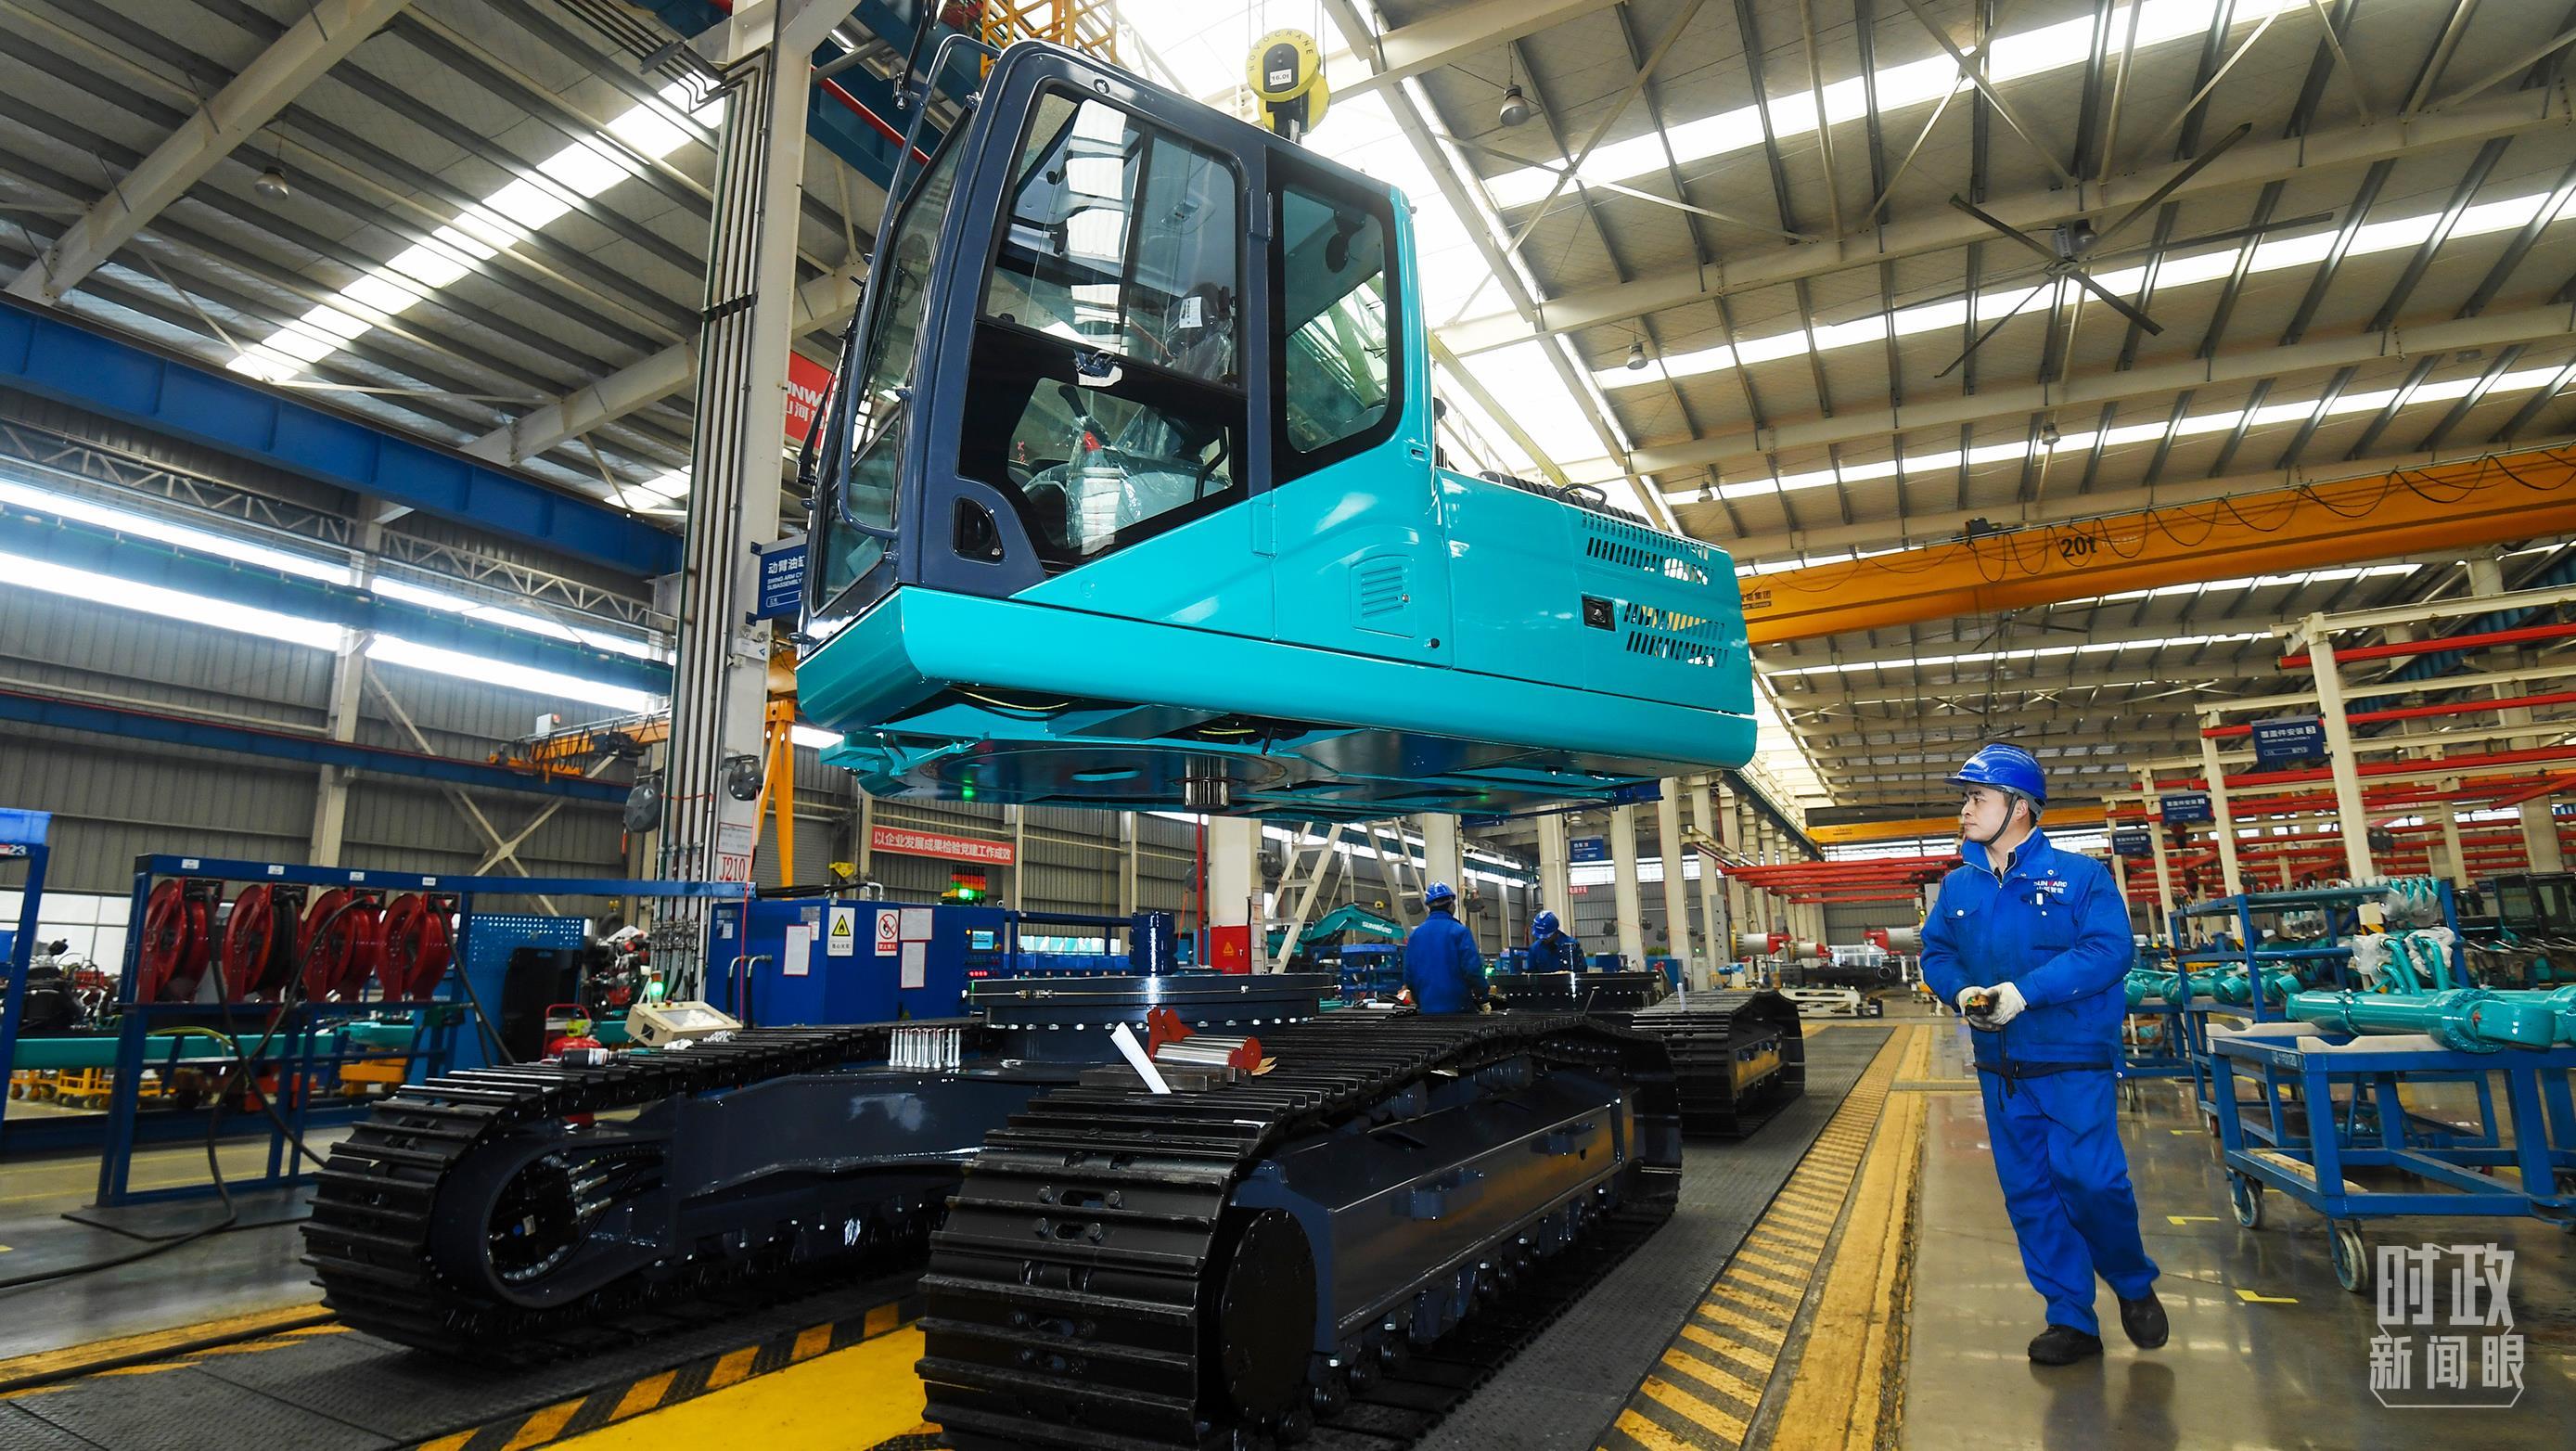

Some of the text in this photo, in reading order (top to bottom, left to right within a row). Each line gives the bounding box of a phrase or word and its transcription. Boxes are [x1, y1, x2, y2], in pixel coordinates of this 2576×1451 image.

[1272, 73, 1289, 82] 16.0t
[2060, 536, 2097, 559] 20t
[874, 830, 1011, 861] 以企业发展成果检验党建工作成效
[719, 856, 746, 881] J210
